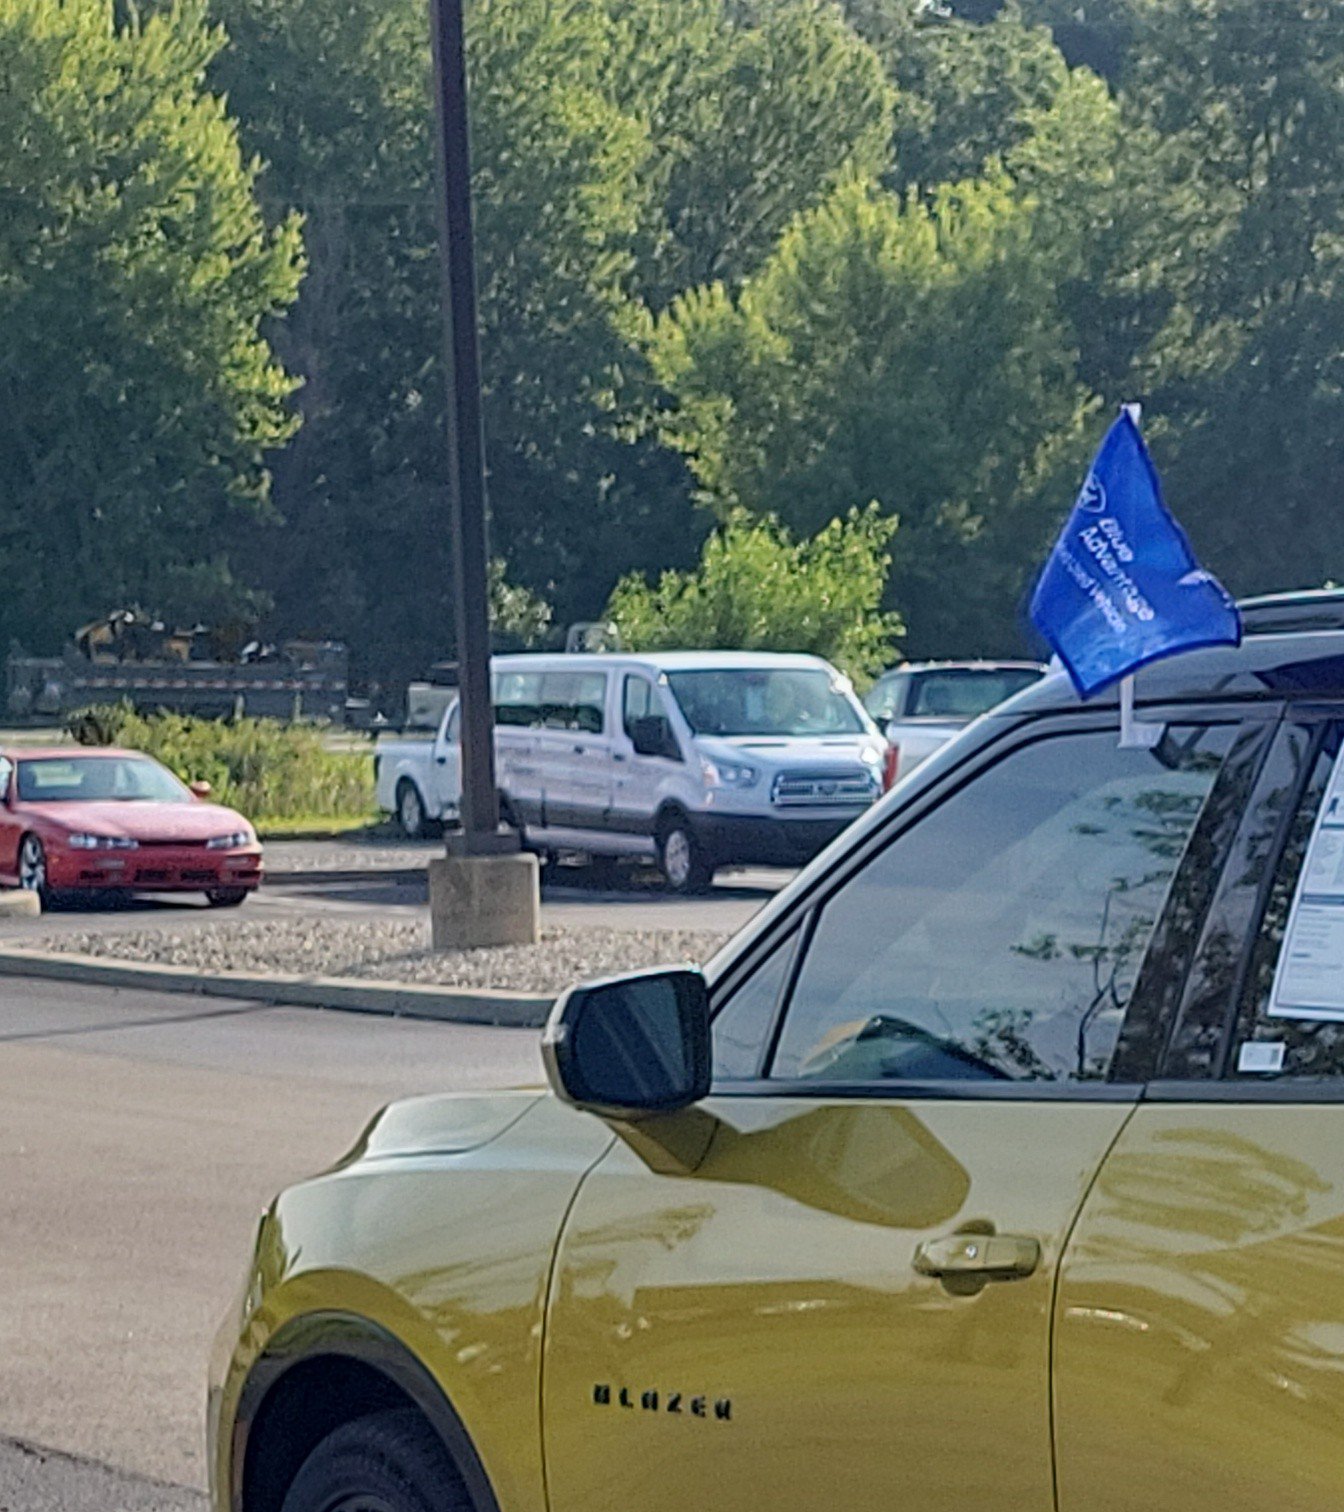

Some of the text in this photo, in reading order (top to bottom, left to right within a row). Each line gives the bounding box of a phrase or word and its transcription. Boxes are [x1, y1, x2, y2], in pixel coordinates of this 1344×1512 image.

[1098, 518, 1134, 562] Blue
[1079, 527, 1155, 621] Advantage
[592, 1384, 732, 1421] BLAZER
